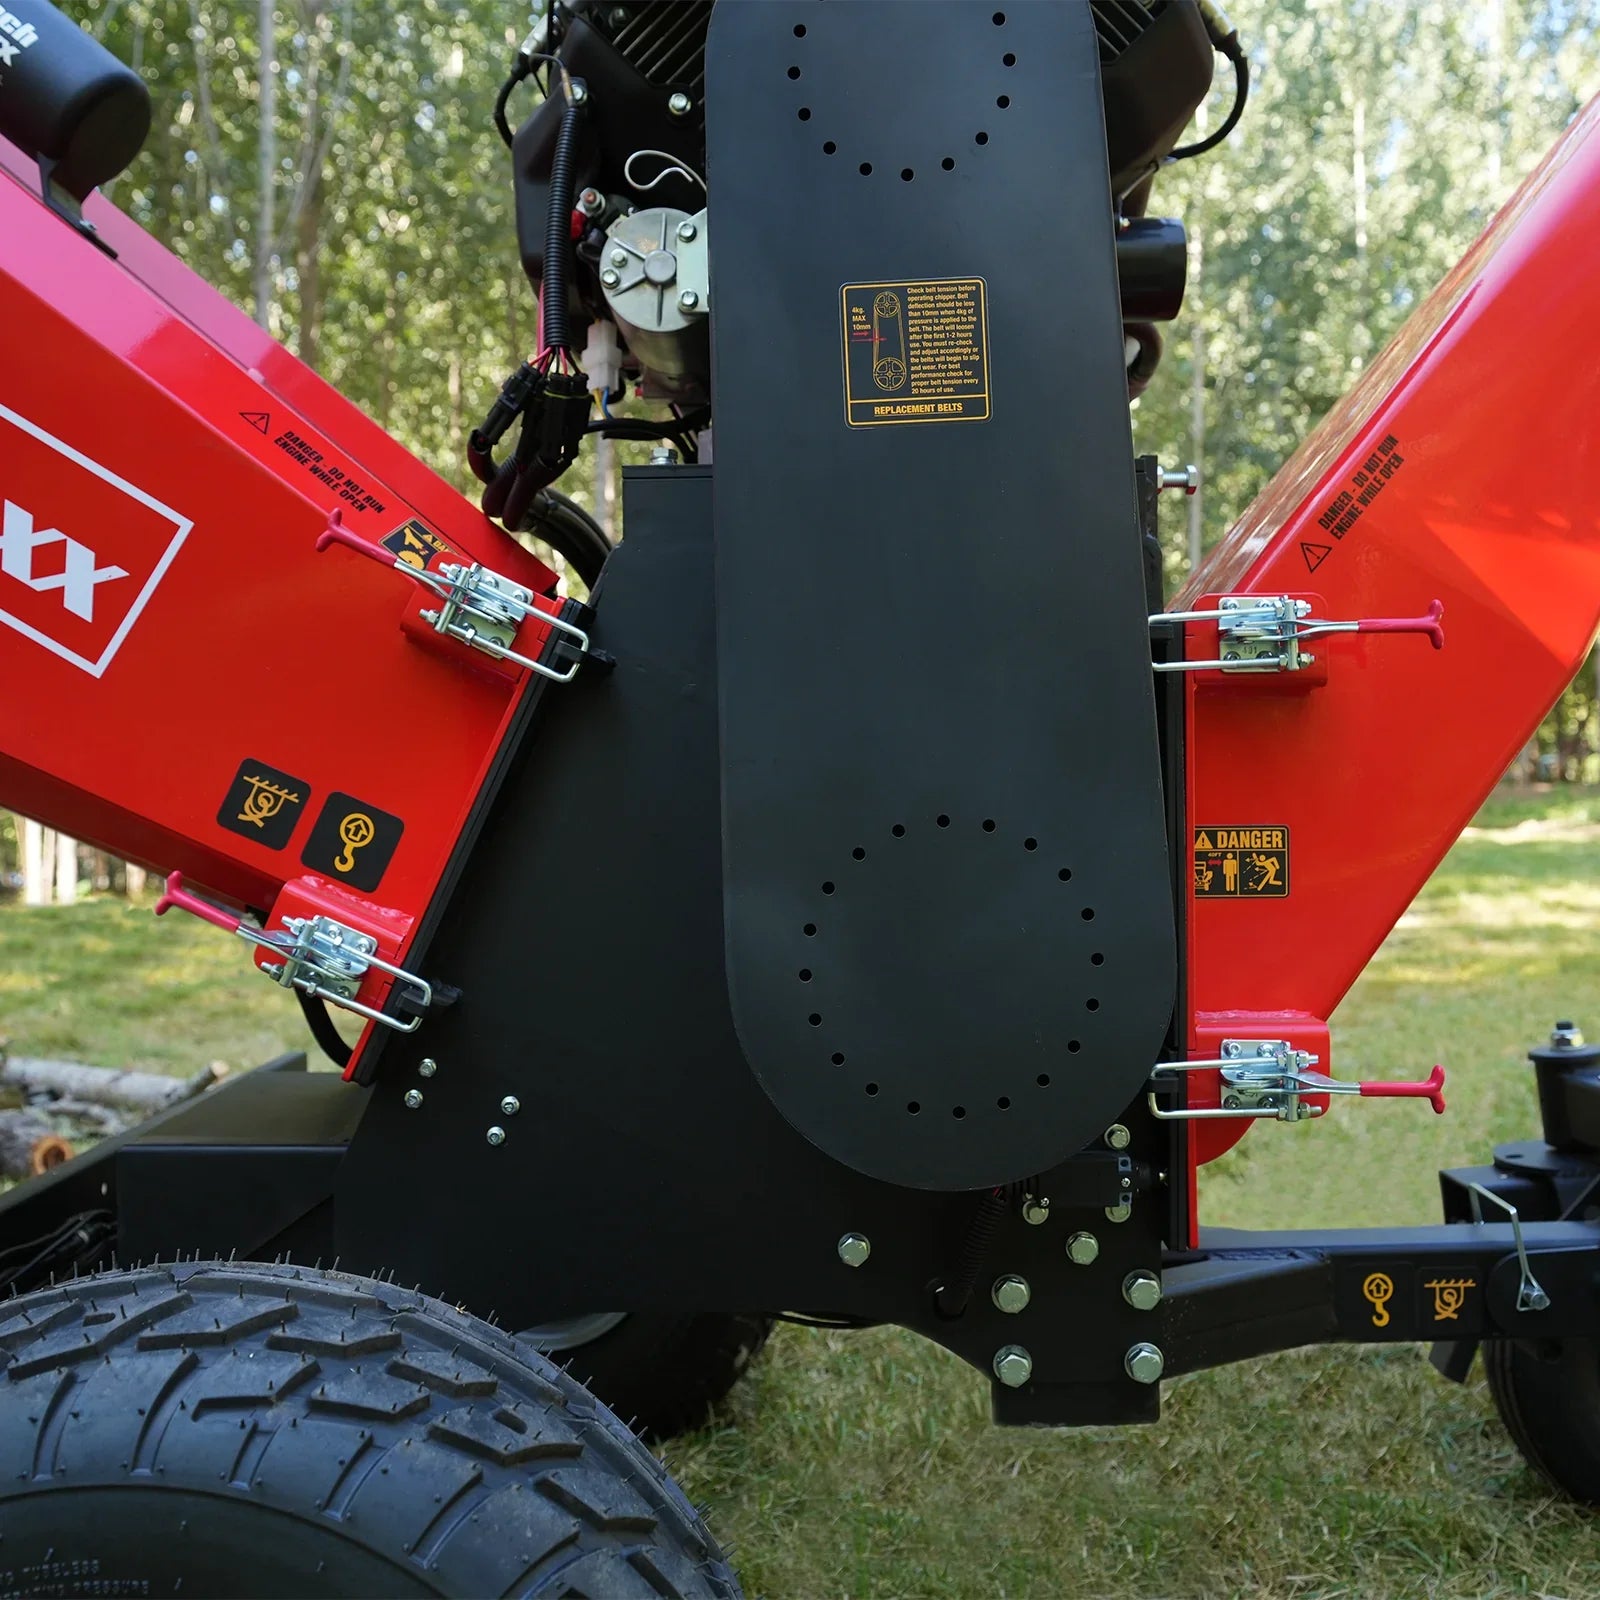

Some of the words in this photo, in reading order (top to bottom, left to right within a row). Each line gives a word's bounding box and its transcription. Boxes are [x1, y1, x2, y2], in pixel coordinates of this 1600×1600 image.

[0, 4, 39, 48] ch
[874, 404, 935, 415] REPLACEMENT
[937, 402, 963, 412] BELTS
[274, 436, 310, 466] ENGINE
[309, 464, 342, 491] WHILE
[339, 489, 367, 512] OPEN
[283, 431, 324, 463] DANGER
[328, 467, 345, 480] DO
[343, 479, 365, 496] NOT
[362, 495, 386, 514] RUN
[1317, 491, 1354, 530] DANGER
[1352, 471, 1369, 488] DO
[1363, 452, 1384, 474] NOT
[1377, 434, 1399, 456] RUN
[1330, 504, 1363, 540] ENGINE
[1356, 476, 1385, 507] WHILE
[1379, 452, 1404, 479] OPEN
[1217, 831, 1282, 848] DANGER
